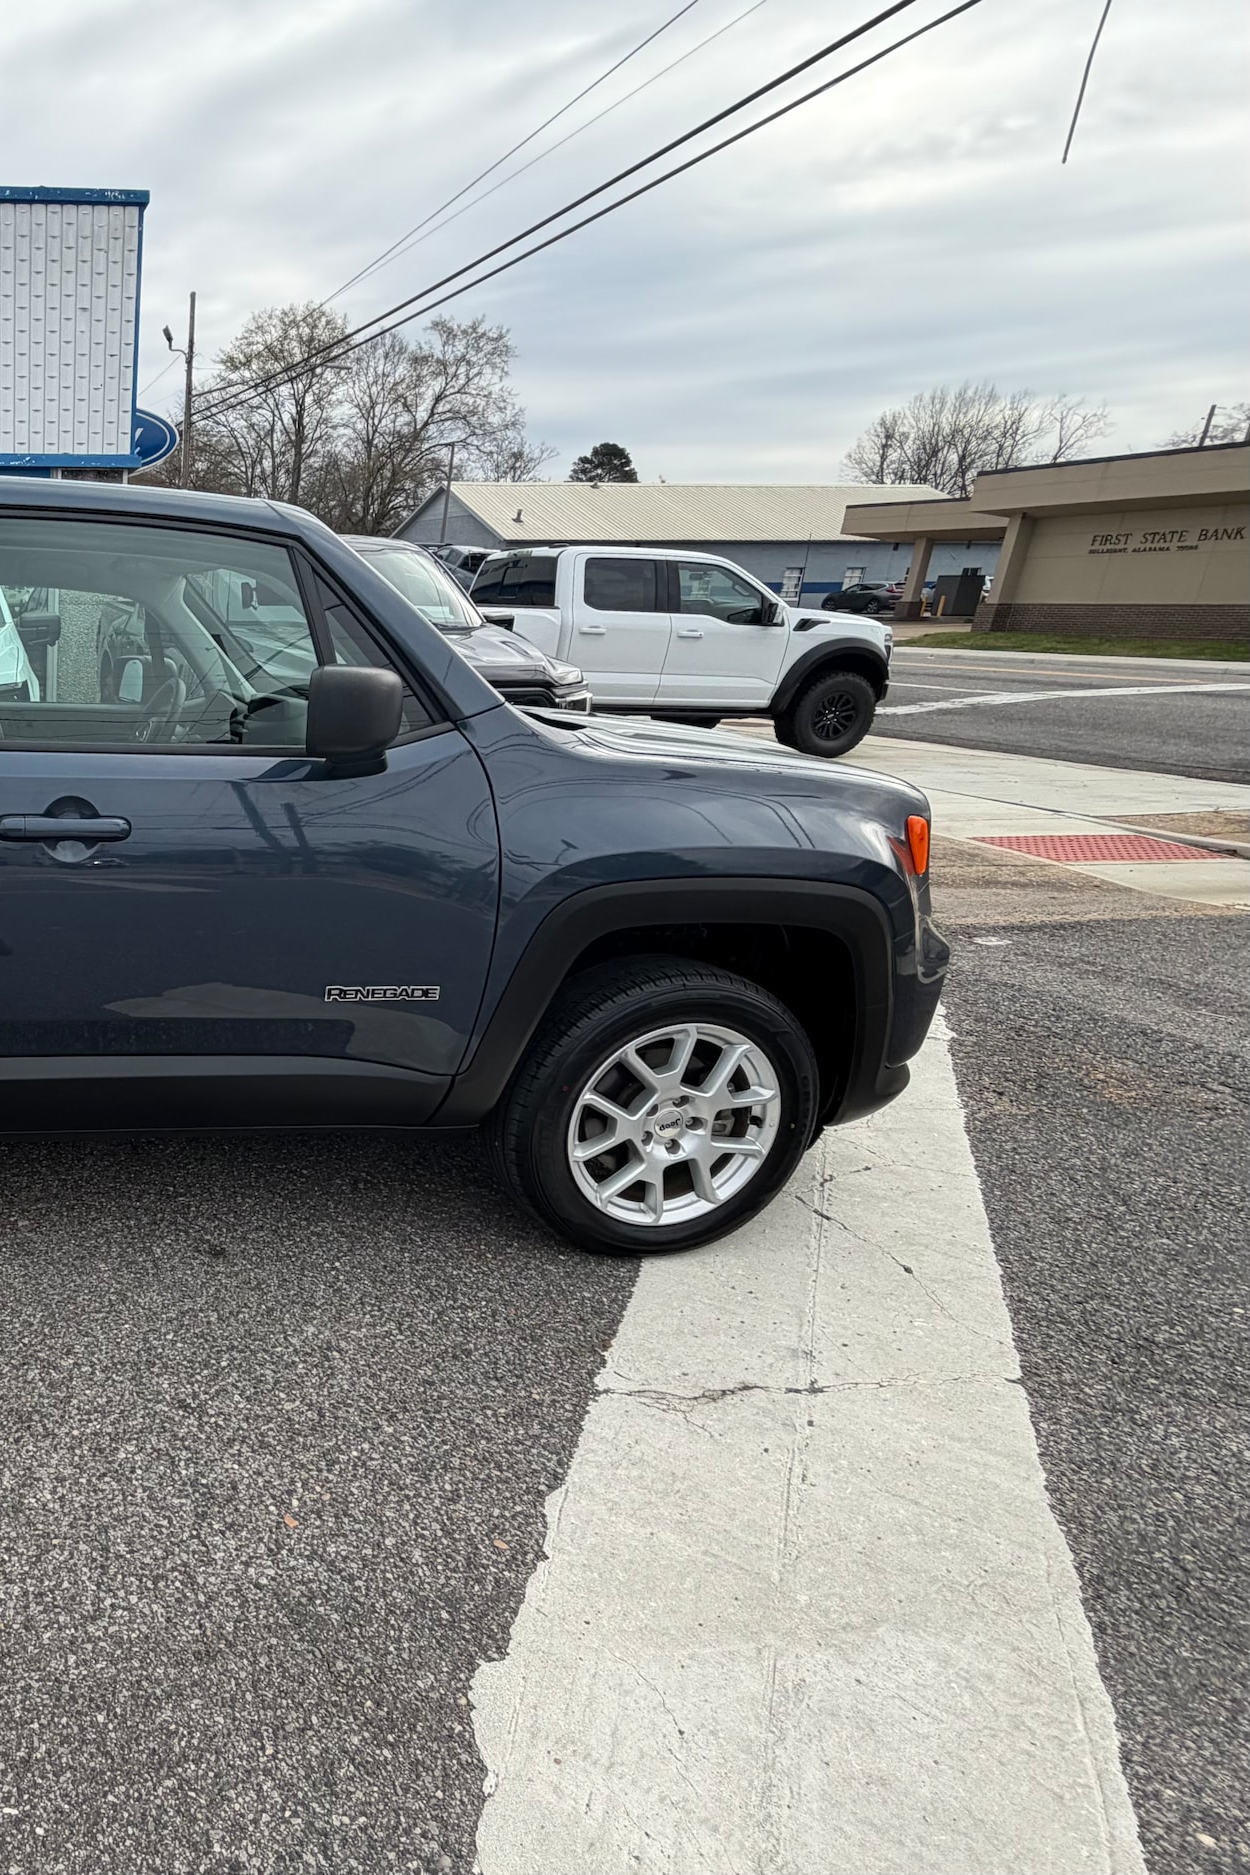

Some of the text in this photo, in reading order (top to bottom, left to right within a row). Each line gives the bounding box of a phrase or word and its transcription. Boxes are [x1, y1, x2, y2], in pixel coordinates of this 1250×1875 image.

[1091, 526, 1247, 547] FIRST STATE BANK
[325, 985, 440, 1002] RENEGADE
[659, 1117, 681, 1131] Jeep
